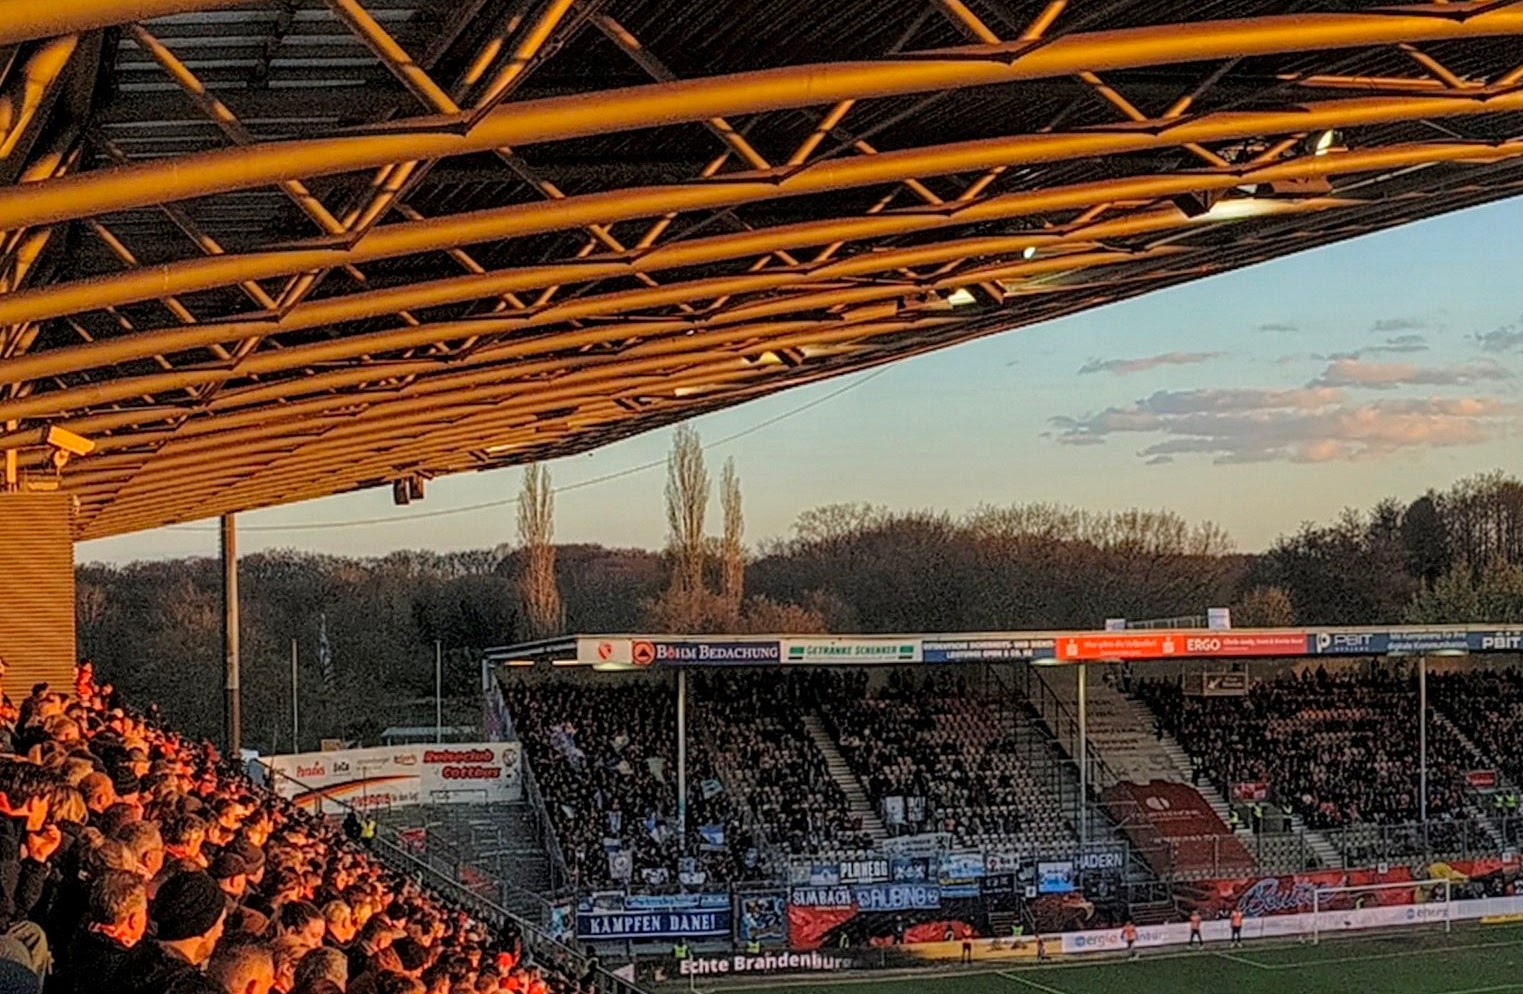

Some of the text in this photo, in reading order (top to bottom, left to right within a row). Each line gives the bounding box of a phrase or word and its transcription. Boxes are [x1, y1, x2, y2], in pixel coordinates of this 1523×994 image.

[698, 642, 779, 660] BEDACHUNG
[1187, 638, 1221, 651] ERGO
[441, 766, 502, 780] Cottbus
[1074, 852, 1123, 870] HADERN
[792, 888, 851, 905] SIMBACH
[670, 914, 716, 931] DANE!
[679, 955, 729, 975] Echte
